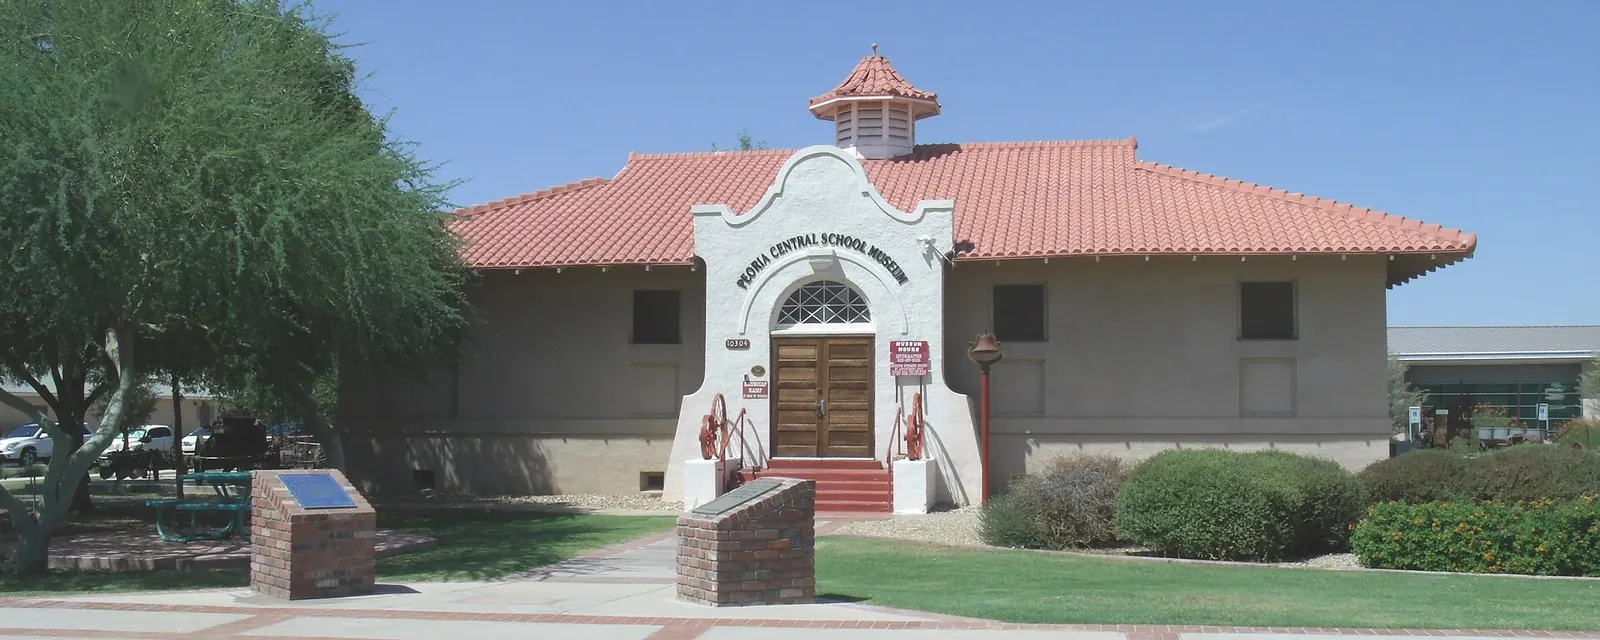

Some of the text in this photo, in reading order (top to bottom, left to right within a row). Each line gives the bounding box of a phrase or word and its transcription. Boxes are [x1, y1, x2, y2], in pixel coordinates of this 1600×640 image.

[737, 233, 909, 290] PEORIA CENTRAL SCHOOL MUSEUM
